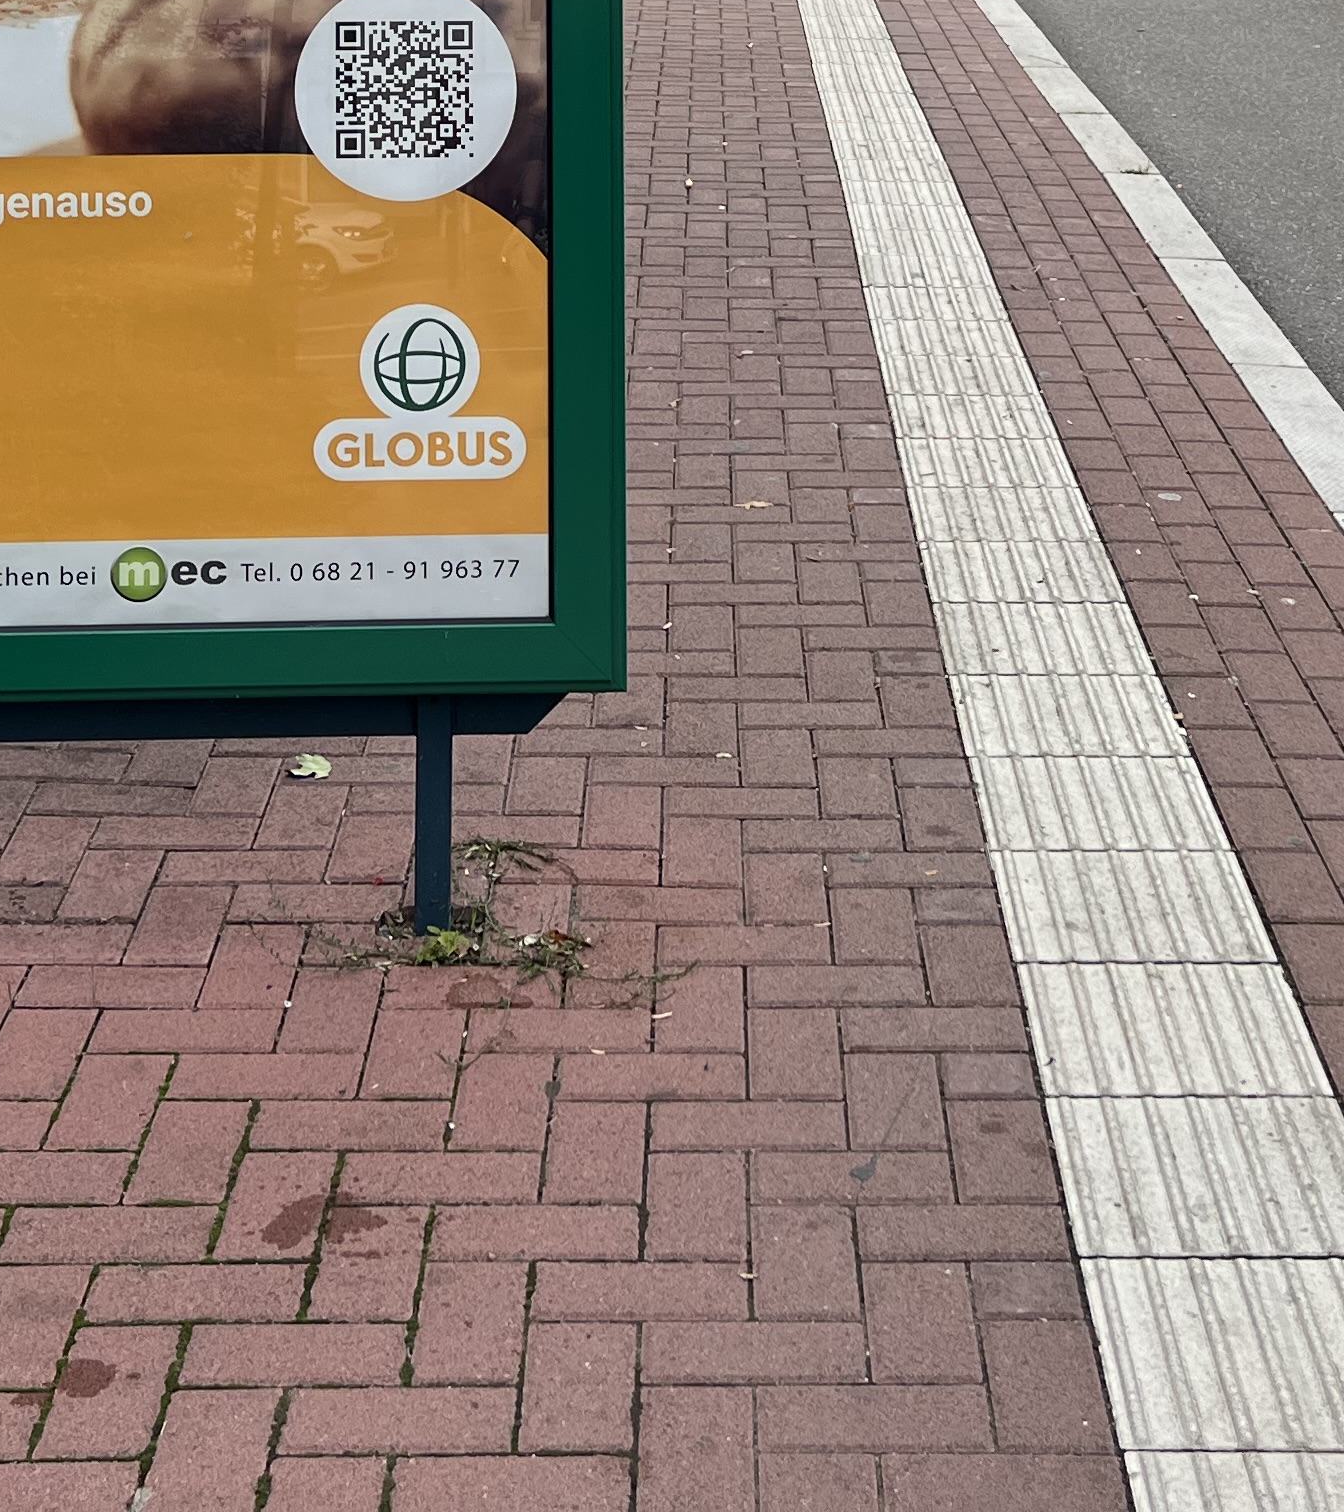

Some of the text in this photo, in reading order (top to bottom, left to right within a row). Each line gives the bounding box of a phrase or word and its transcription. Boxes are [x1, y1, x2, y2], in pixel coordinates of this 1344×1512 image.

[328, 432, 513, 468] GLOBUS
[60, 565, 96, 586] bei
[117, 560, 228, 588] mec
[240, 561, 281, 583] Tel.
[290, 562, 303, 582] 0
[312, 562, 340, 582] 68
[349, 561, 374, 581] 21
[403, 561, 428, 580] 91
[440, 559, 483, 579] 963
[492, 559, 520, 579] 77
